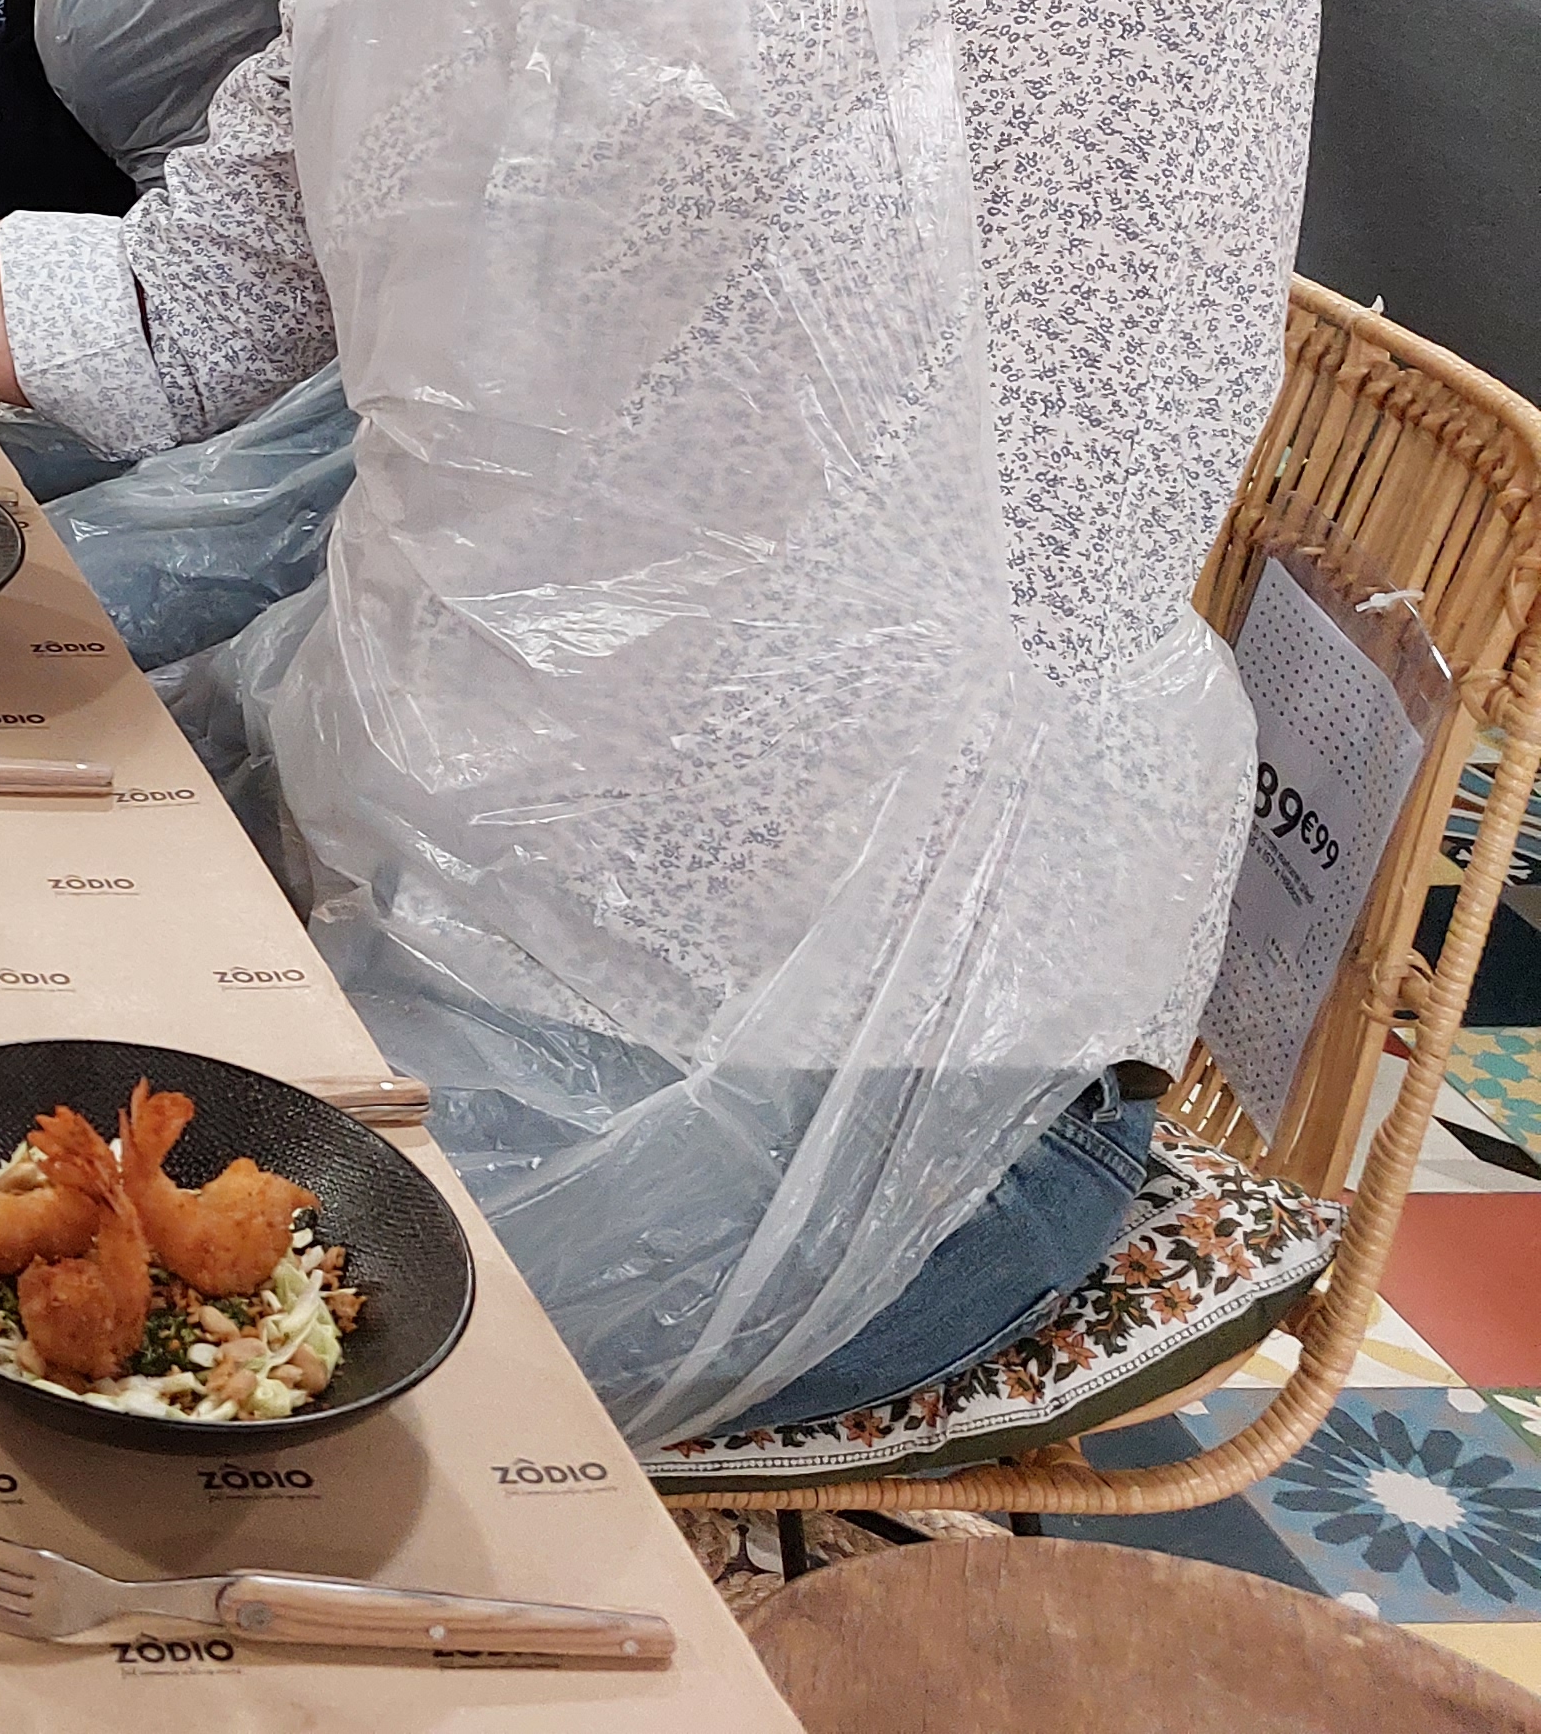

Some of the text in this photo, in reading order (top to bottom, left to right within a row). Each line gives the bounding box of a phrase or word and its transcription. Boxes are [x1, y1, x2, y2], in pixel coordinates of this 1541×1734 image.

[31, 642, 105, 654] ZÔDIO
[117, 789, 195, 804] ZÔDIO
[48, 875, 134, 890] ZÔDIO
[213, 966, 304, 985] ZÔDIO
[198, 1463, 313, 1490] ZÔDIO
[492, 1458, 608, 1484] ZÔDIO
[116, 1634, 235, 1663] ZÔDIO
